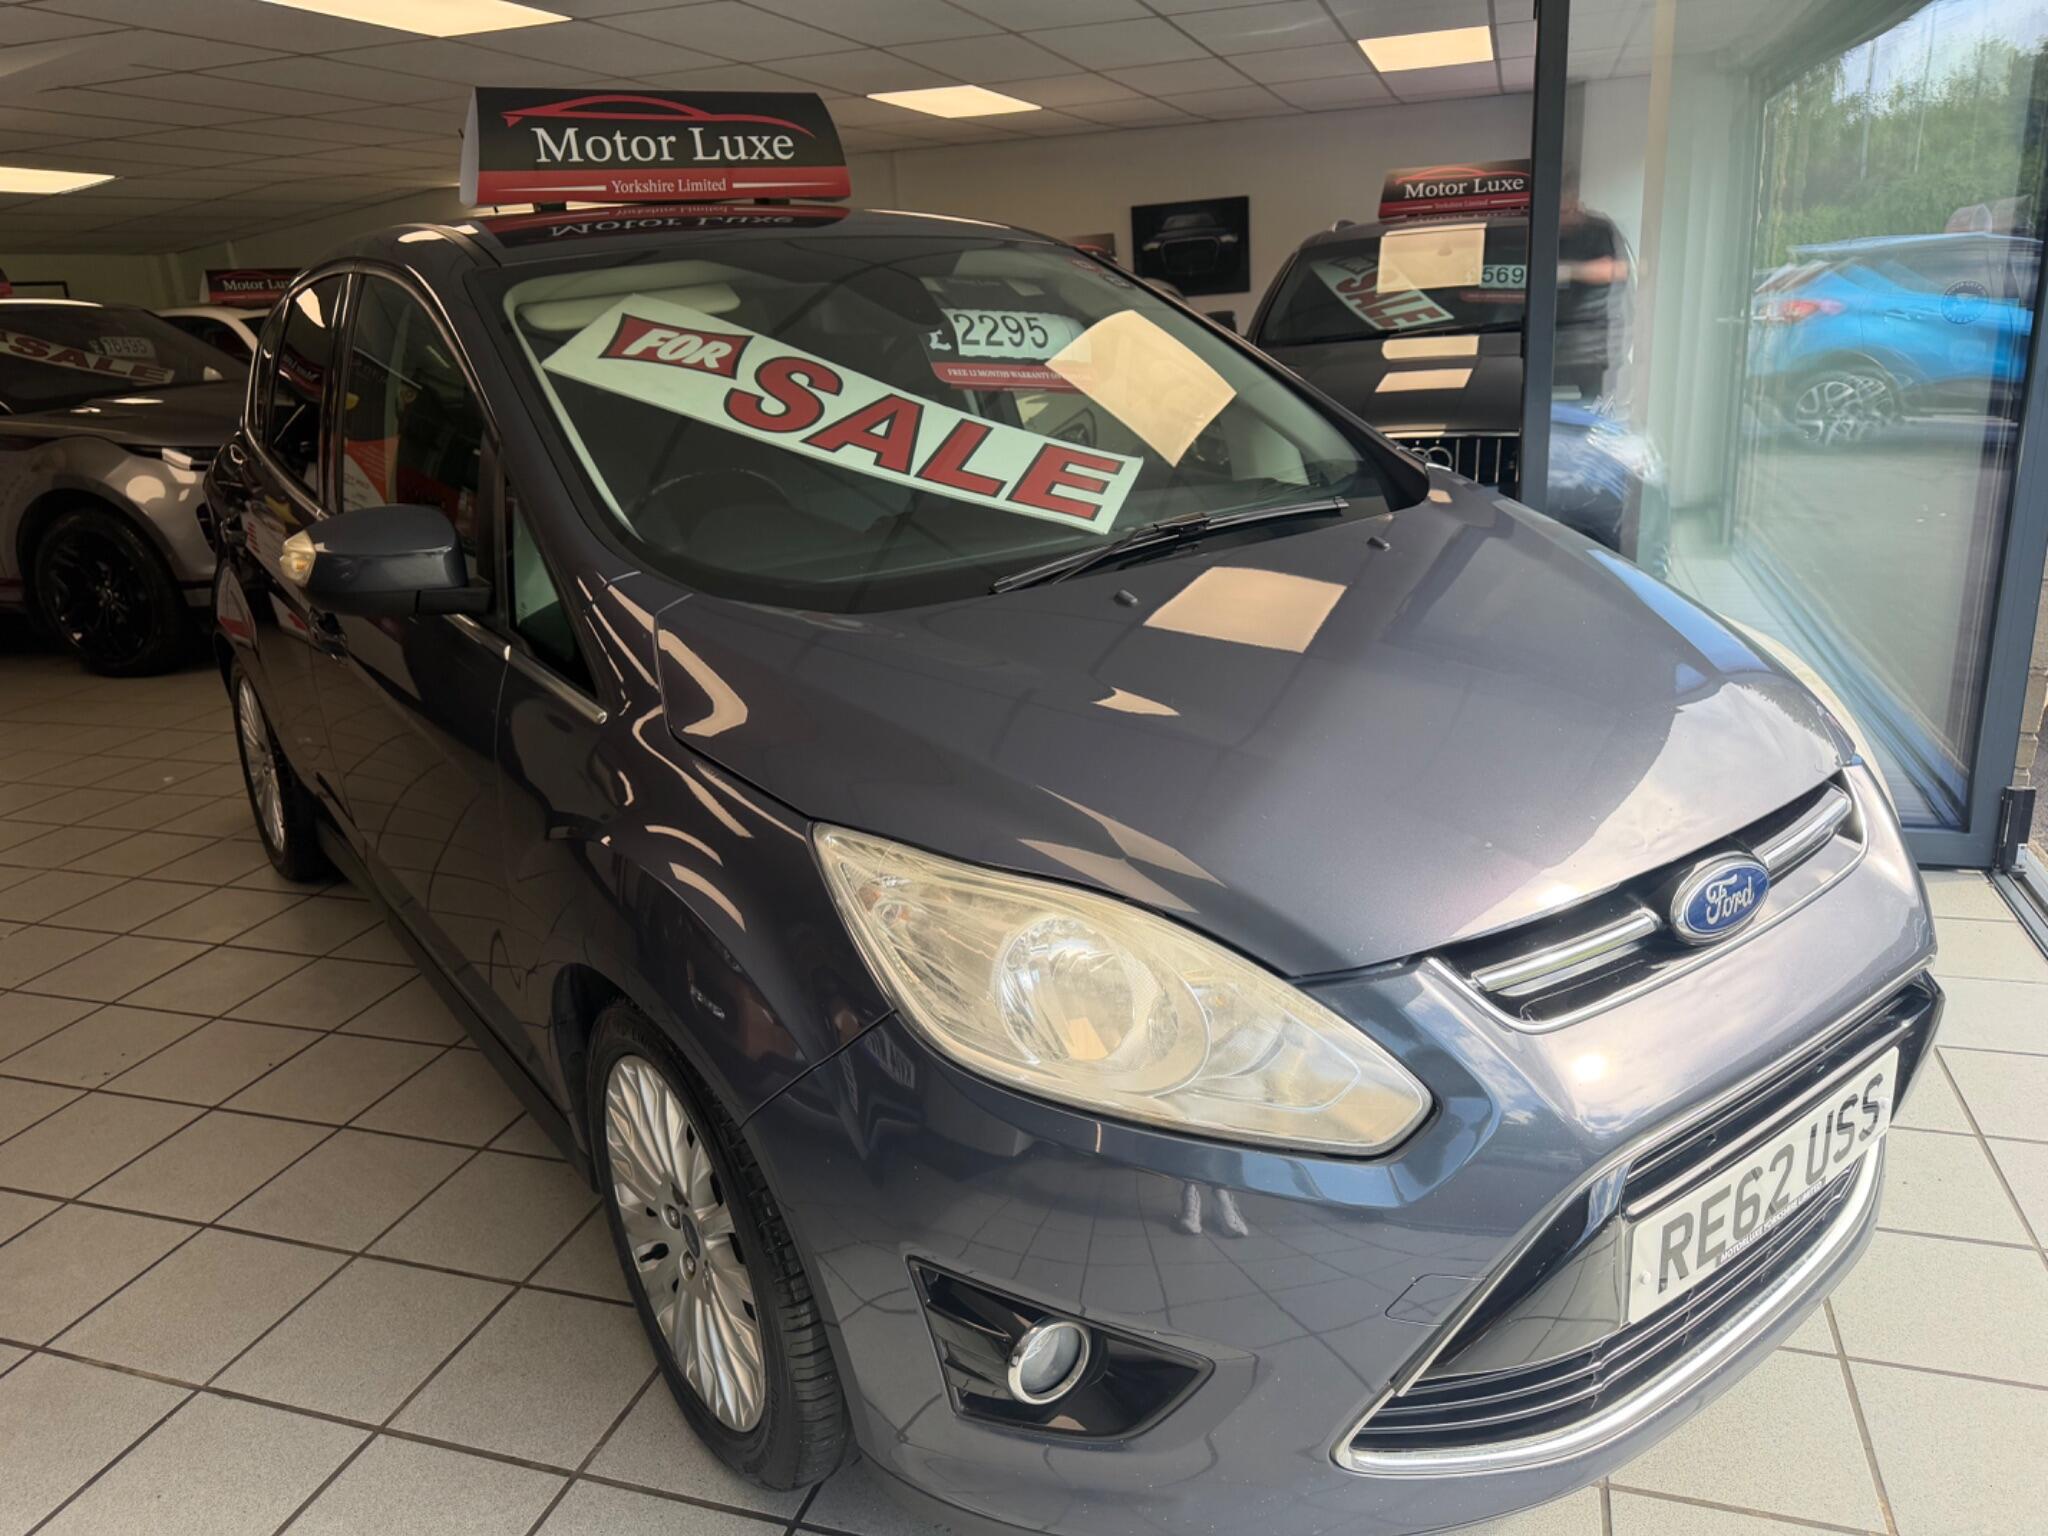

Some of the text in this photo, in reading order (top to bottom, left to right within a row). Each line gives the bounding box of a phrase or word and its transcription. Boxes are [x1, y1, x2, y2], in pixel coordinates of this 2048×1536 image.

[531, 127, 794, 163] Motor Luxe
[612, 178, 727, 194] Yorkshire Limited
[1404, 177, 1524, 199] Motor Luxe
[223, 279, 264, 291] Motor
[9, 336, 166, 382] SALE
[621, 328, 1124, 520] FOR SALE
[1706, 874, 1754, 925] Ford
[1658, 1073, 1883, 1294] RE62 USS
